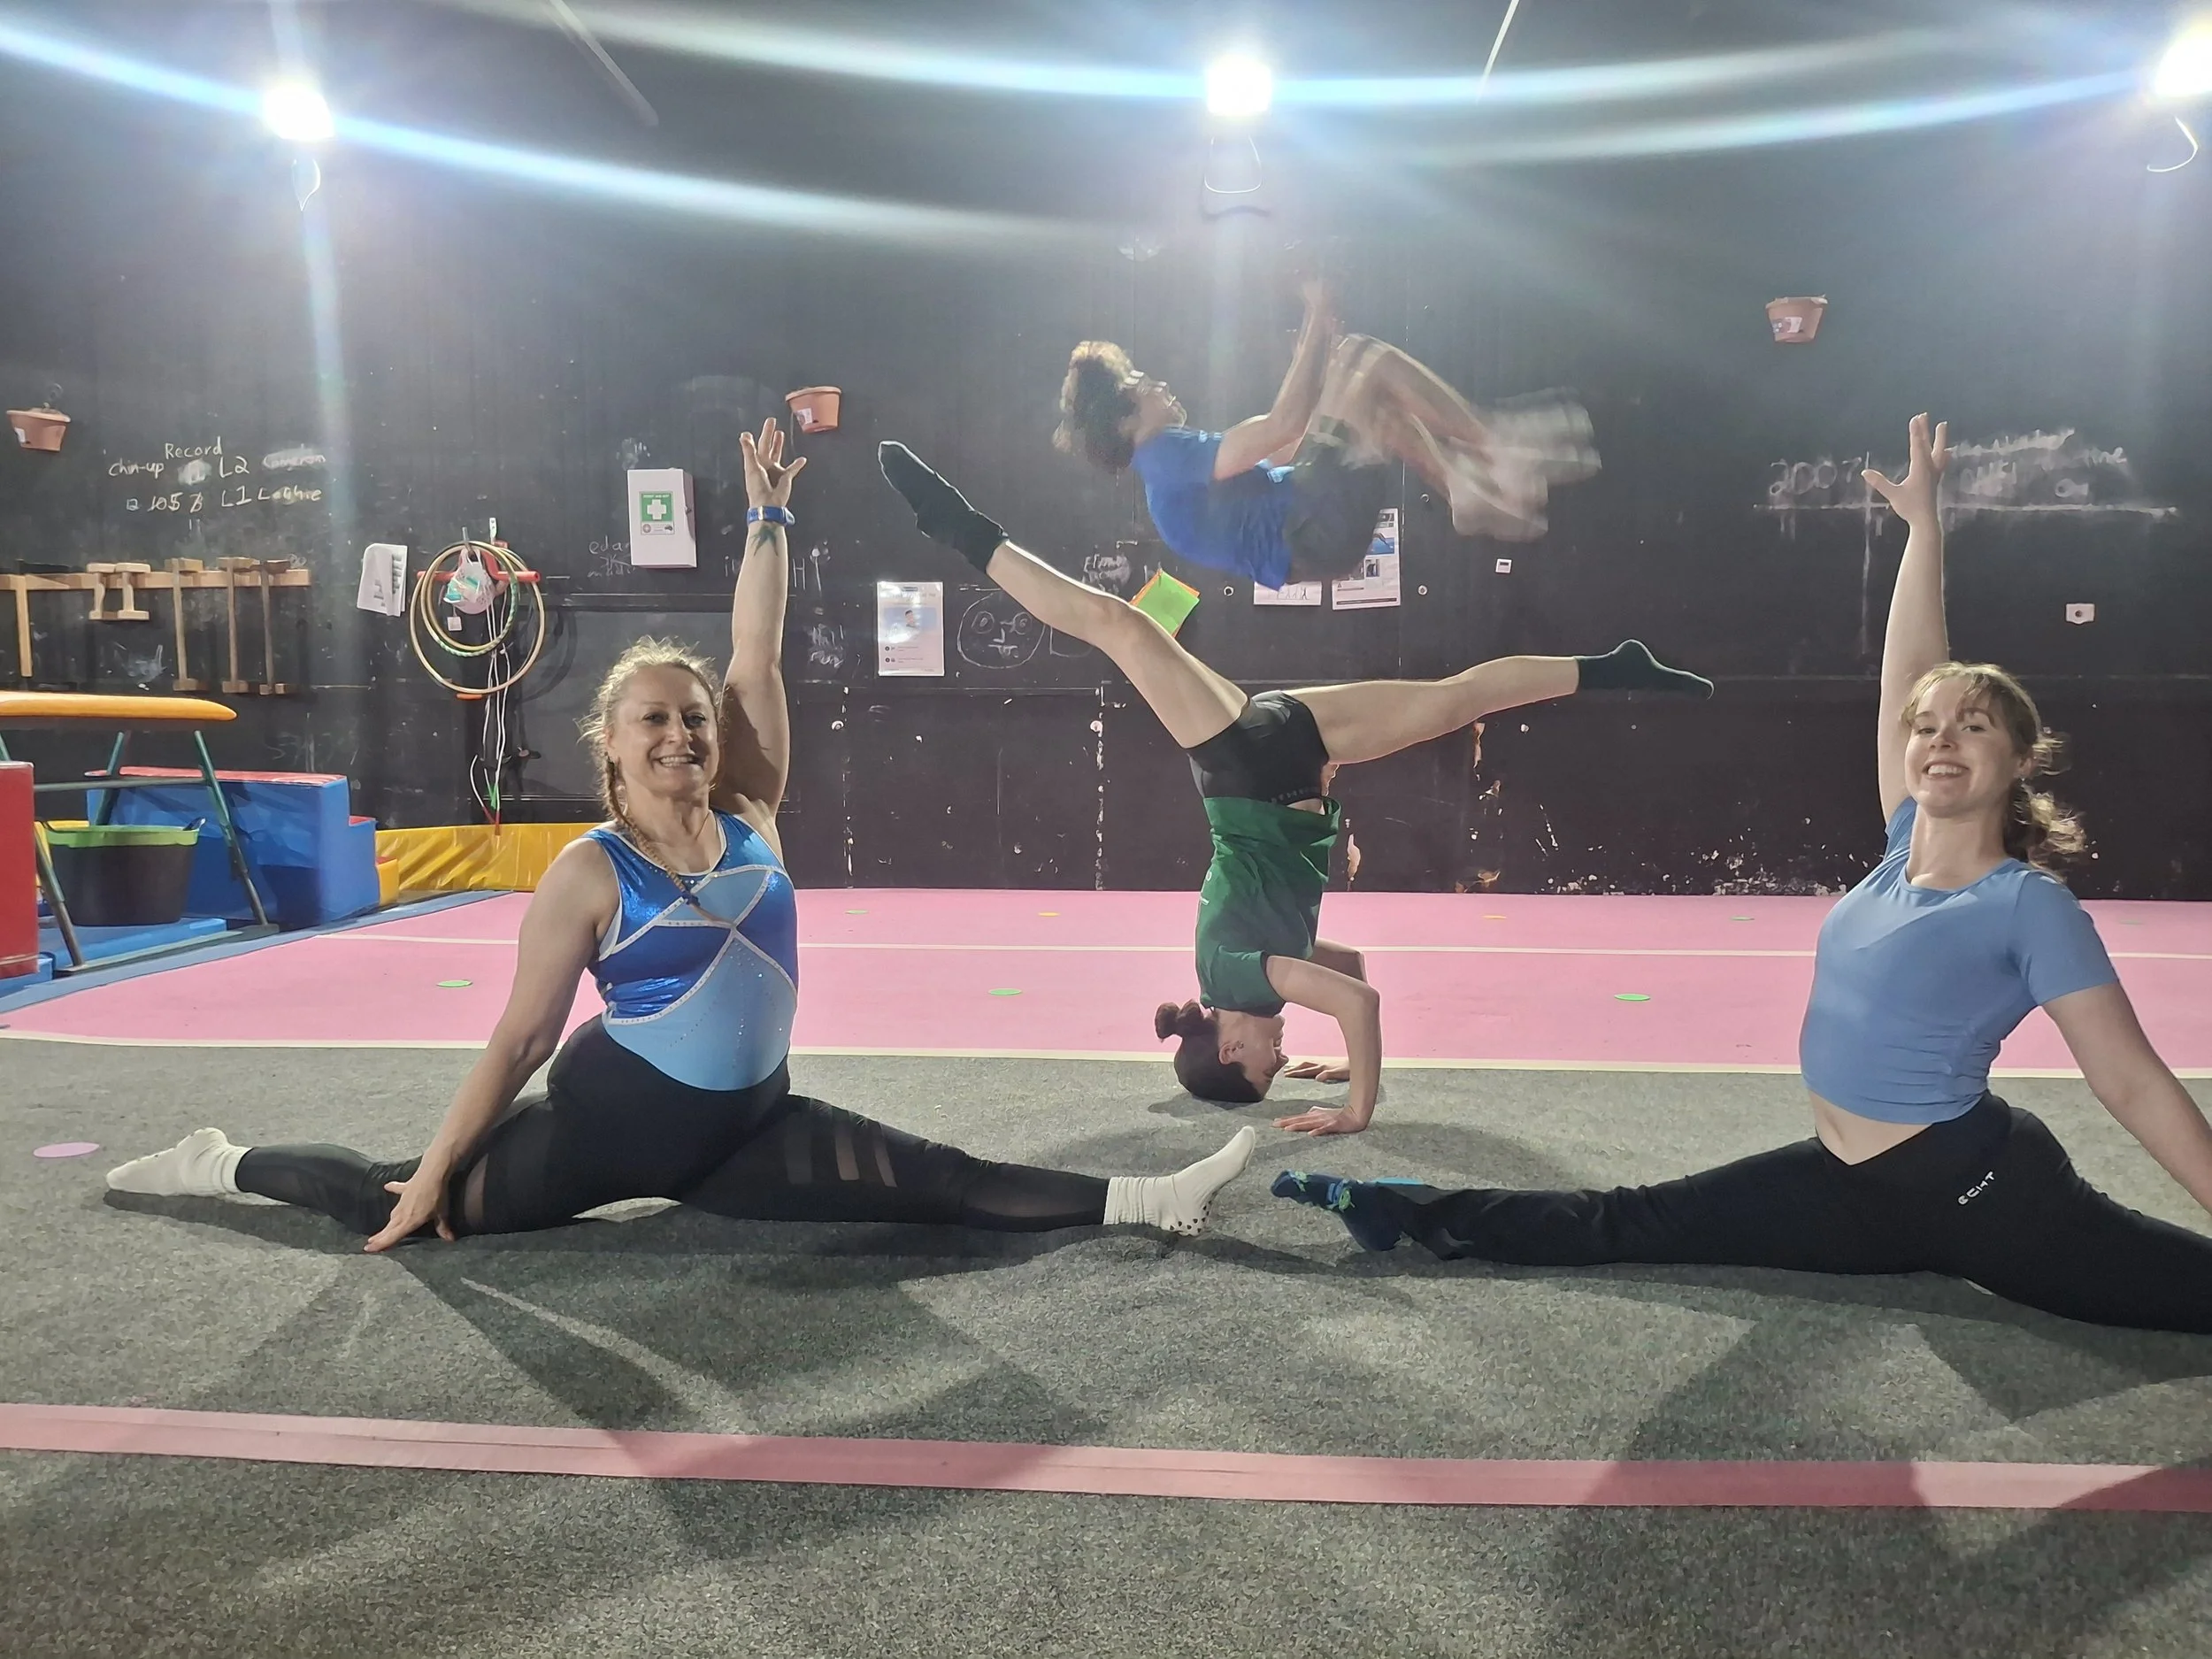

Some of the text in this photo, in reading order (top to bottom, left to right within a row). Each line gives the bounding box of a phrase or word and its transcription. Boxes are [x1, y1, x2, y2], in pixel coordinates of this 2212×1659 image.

[165, 436, 222, 459] Record
[219, 456, 250, 478] L2
[221, 486, 252, 508] L1
